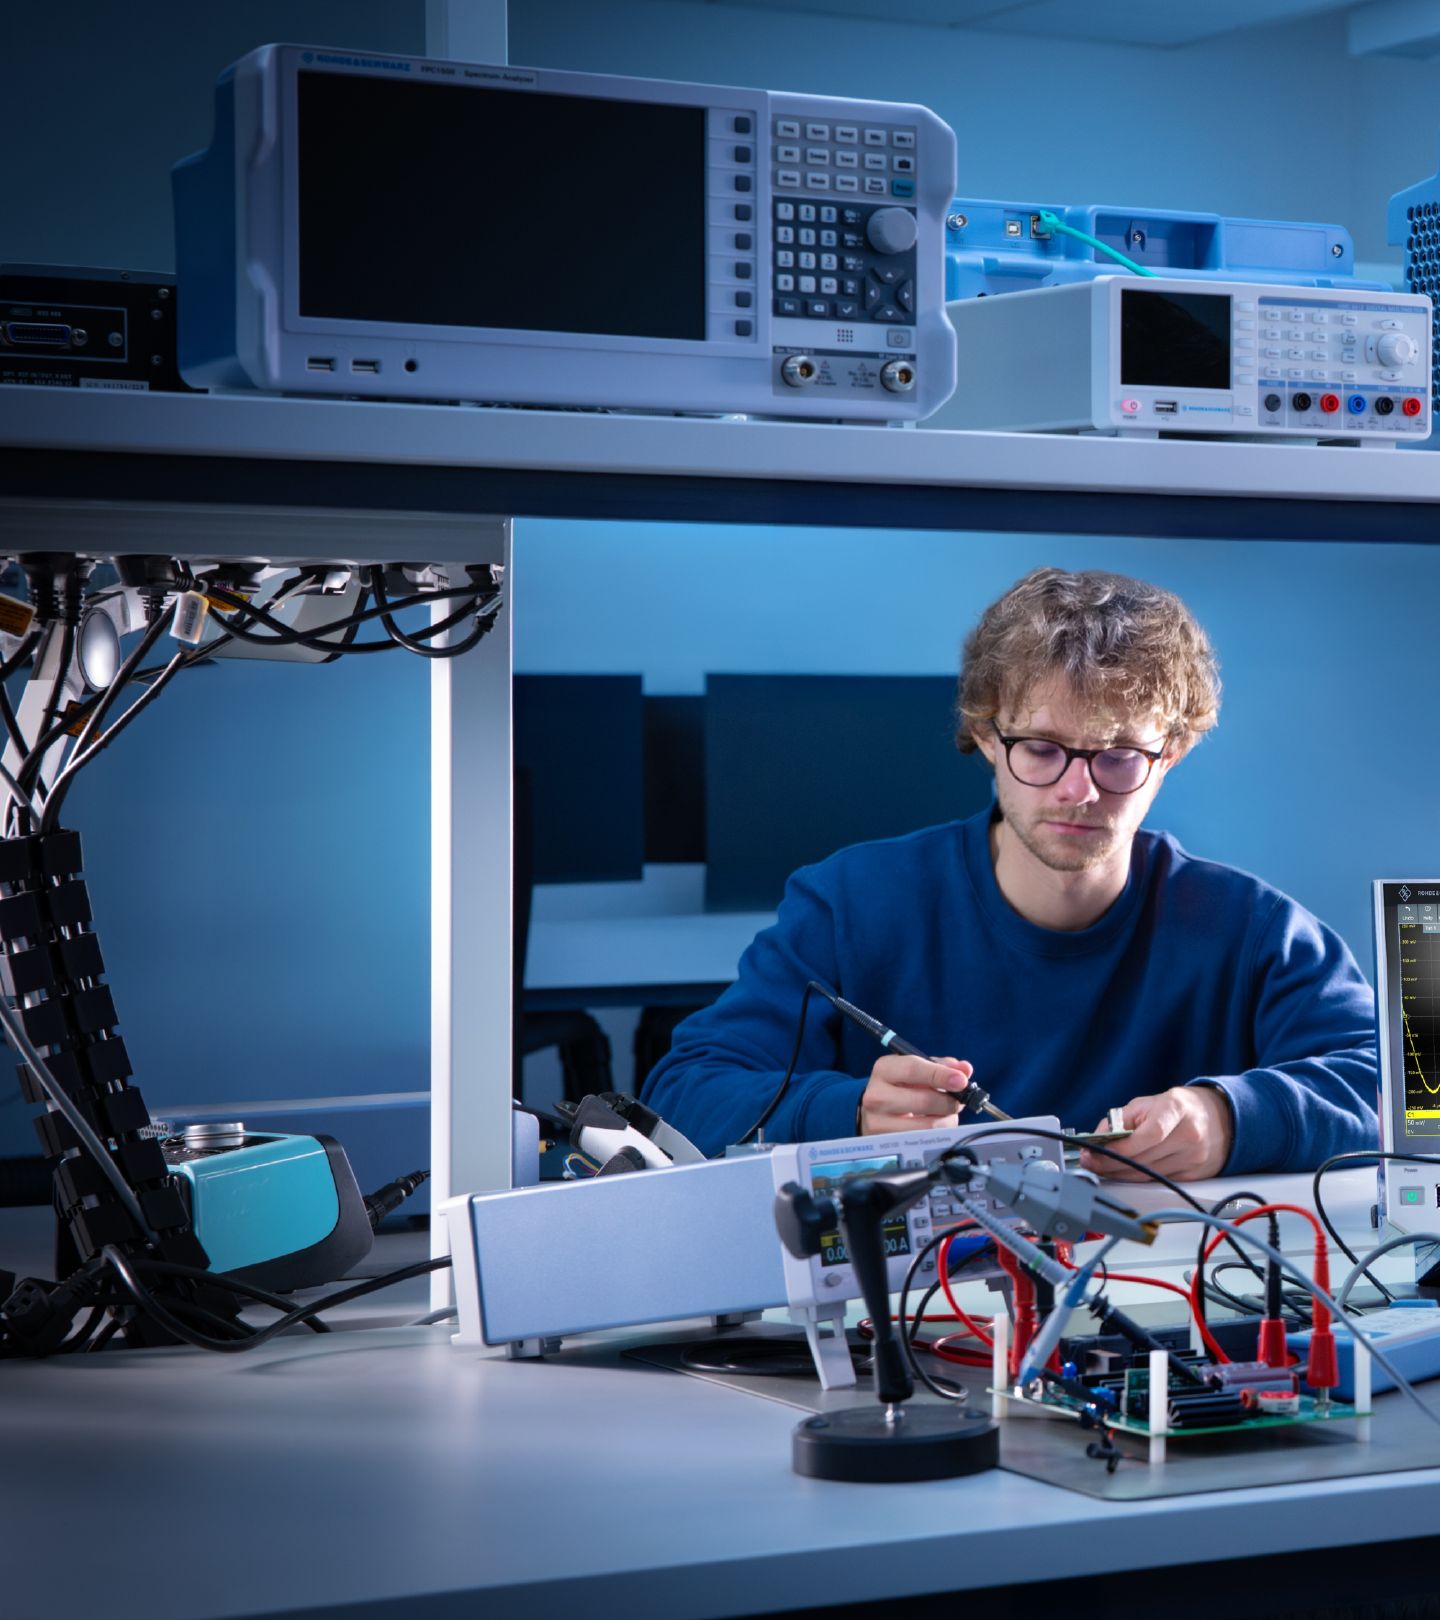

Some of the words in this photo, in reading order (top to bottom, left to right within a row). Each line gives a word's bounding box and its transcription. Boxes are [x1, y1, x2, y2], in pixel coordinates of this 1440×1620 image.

[316, 55, 411, 72] ROHDE&SCHWARZ
[502, 74, 534, 84] Analyzer
[899, 1237, 908, 1251] A
